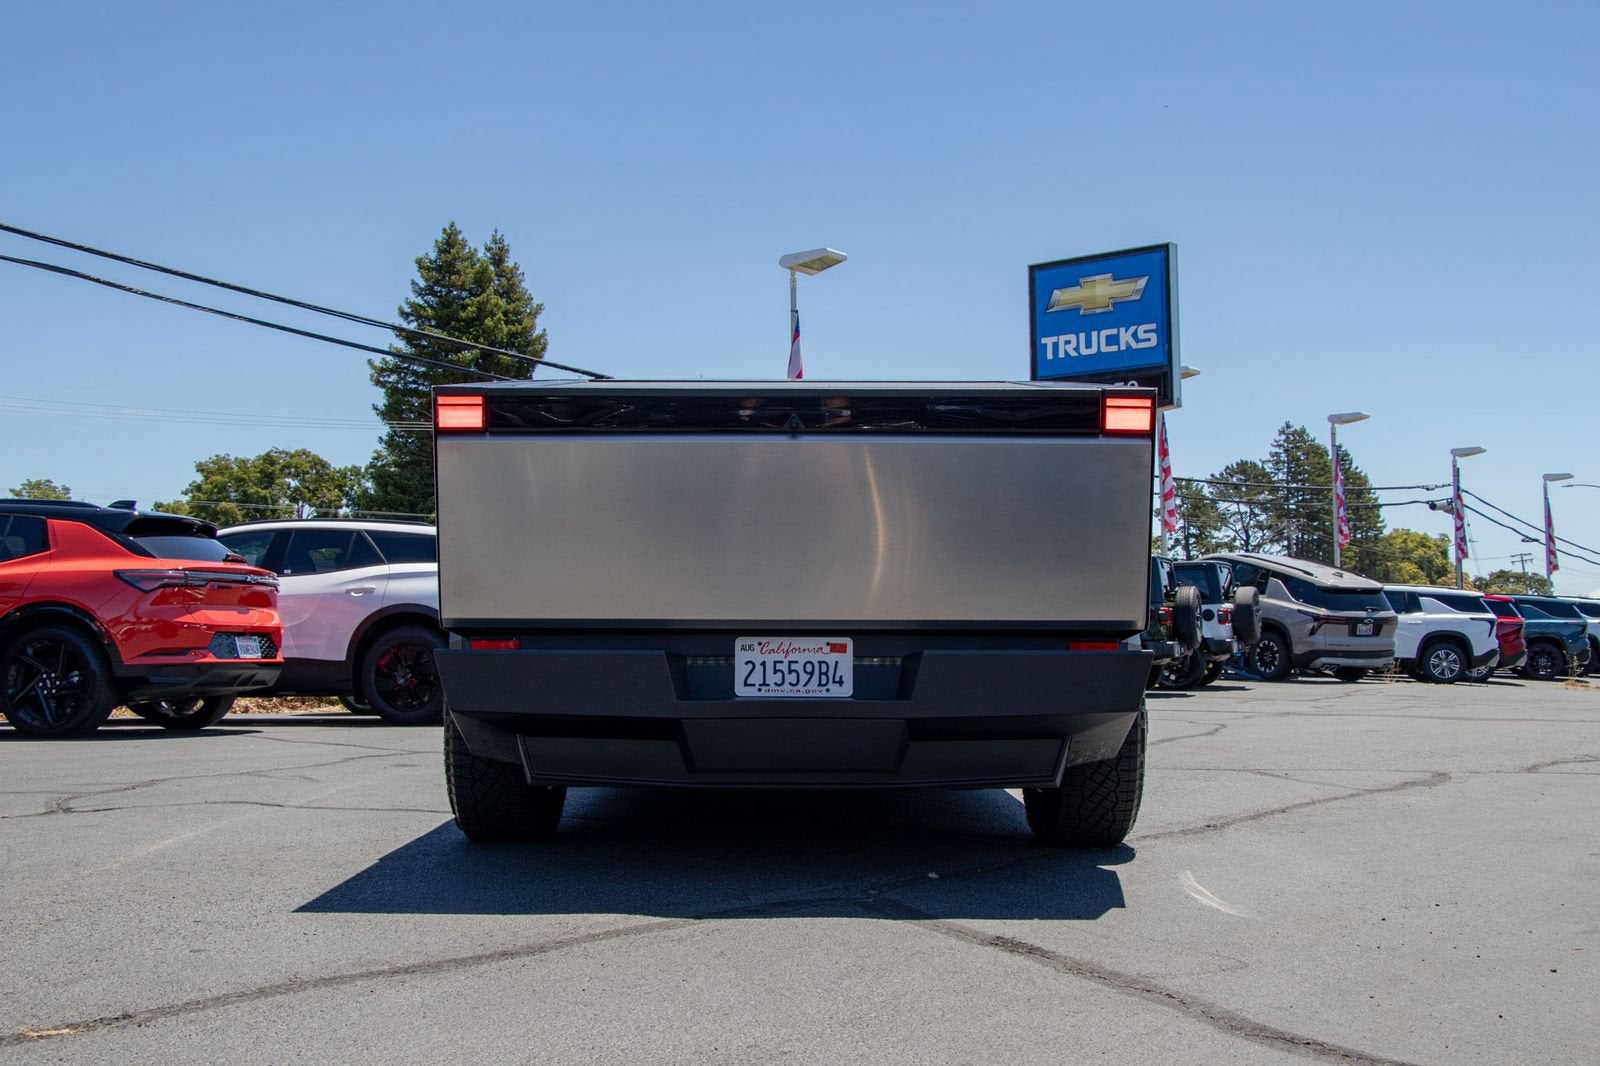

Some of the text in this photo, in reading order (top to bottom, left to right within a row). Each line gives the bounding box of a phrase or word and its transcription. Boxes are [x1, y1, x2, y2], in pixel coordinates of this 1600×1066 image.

[1041, 323, 1158, 360] TRUCKS
[740, 641, 828, 659] AUG California
[743, 660, 845, 687] 21559B4
